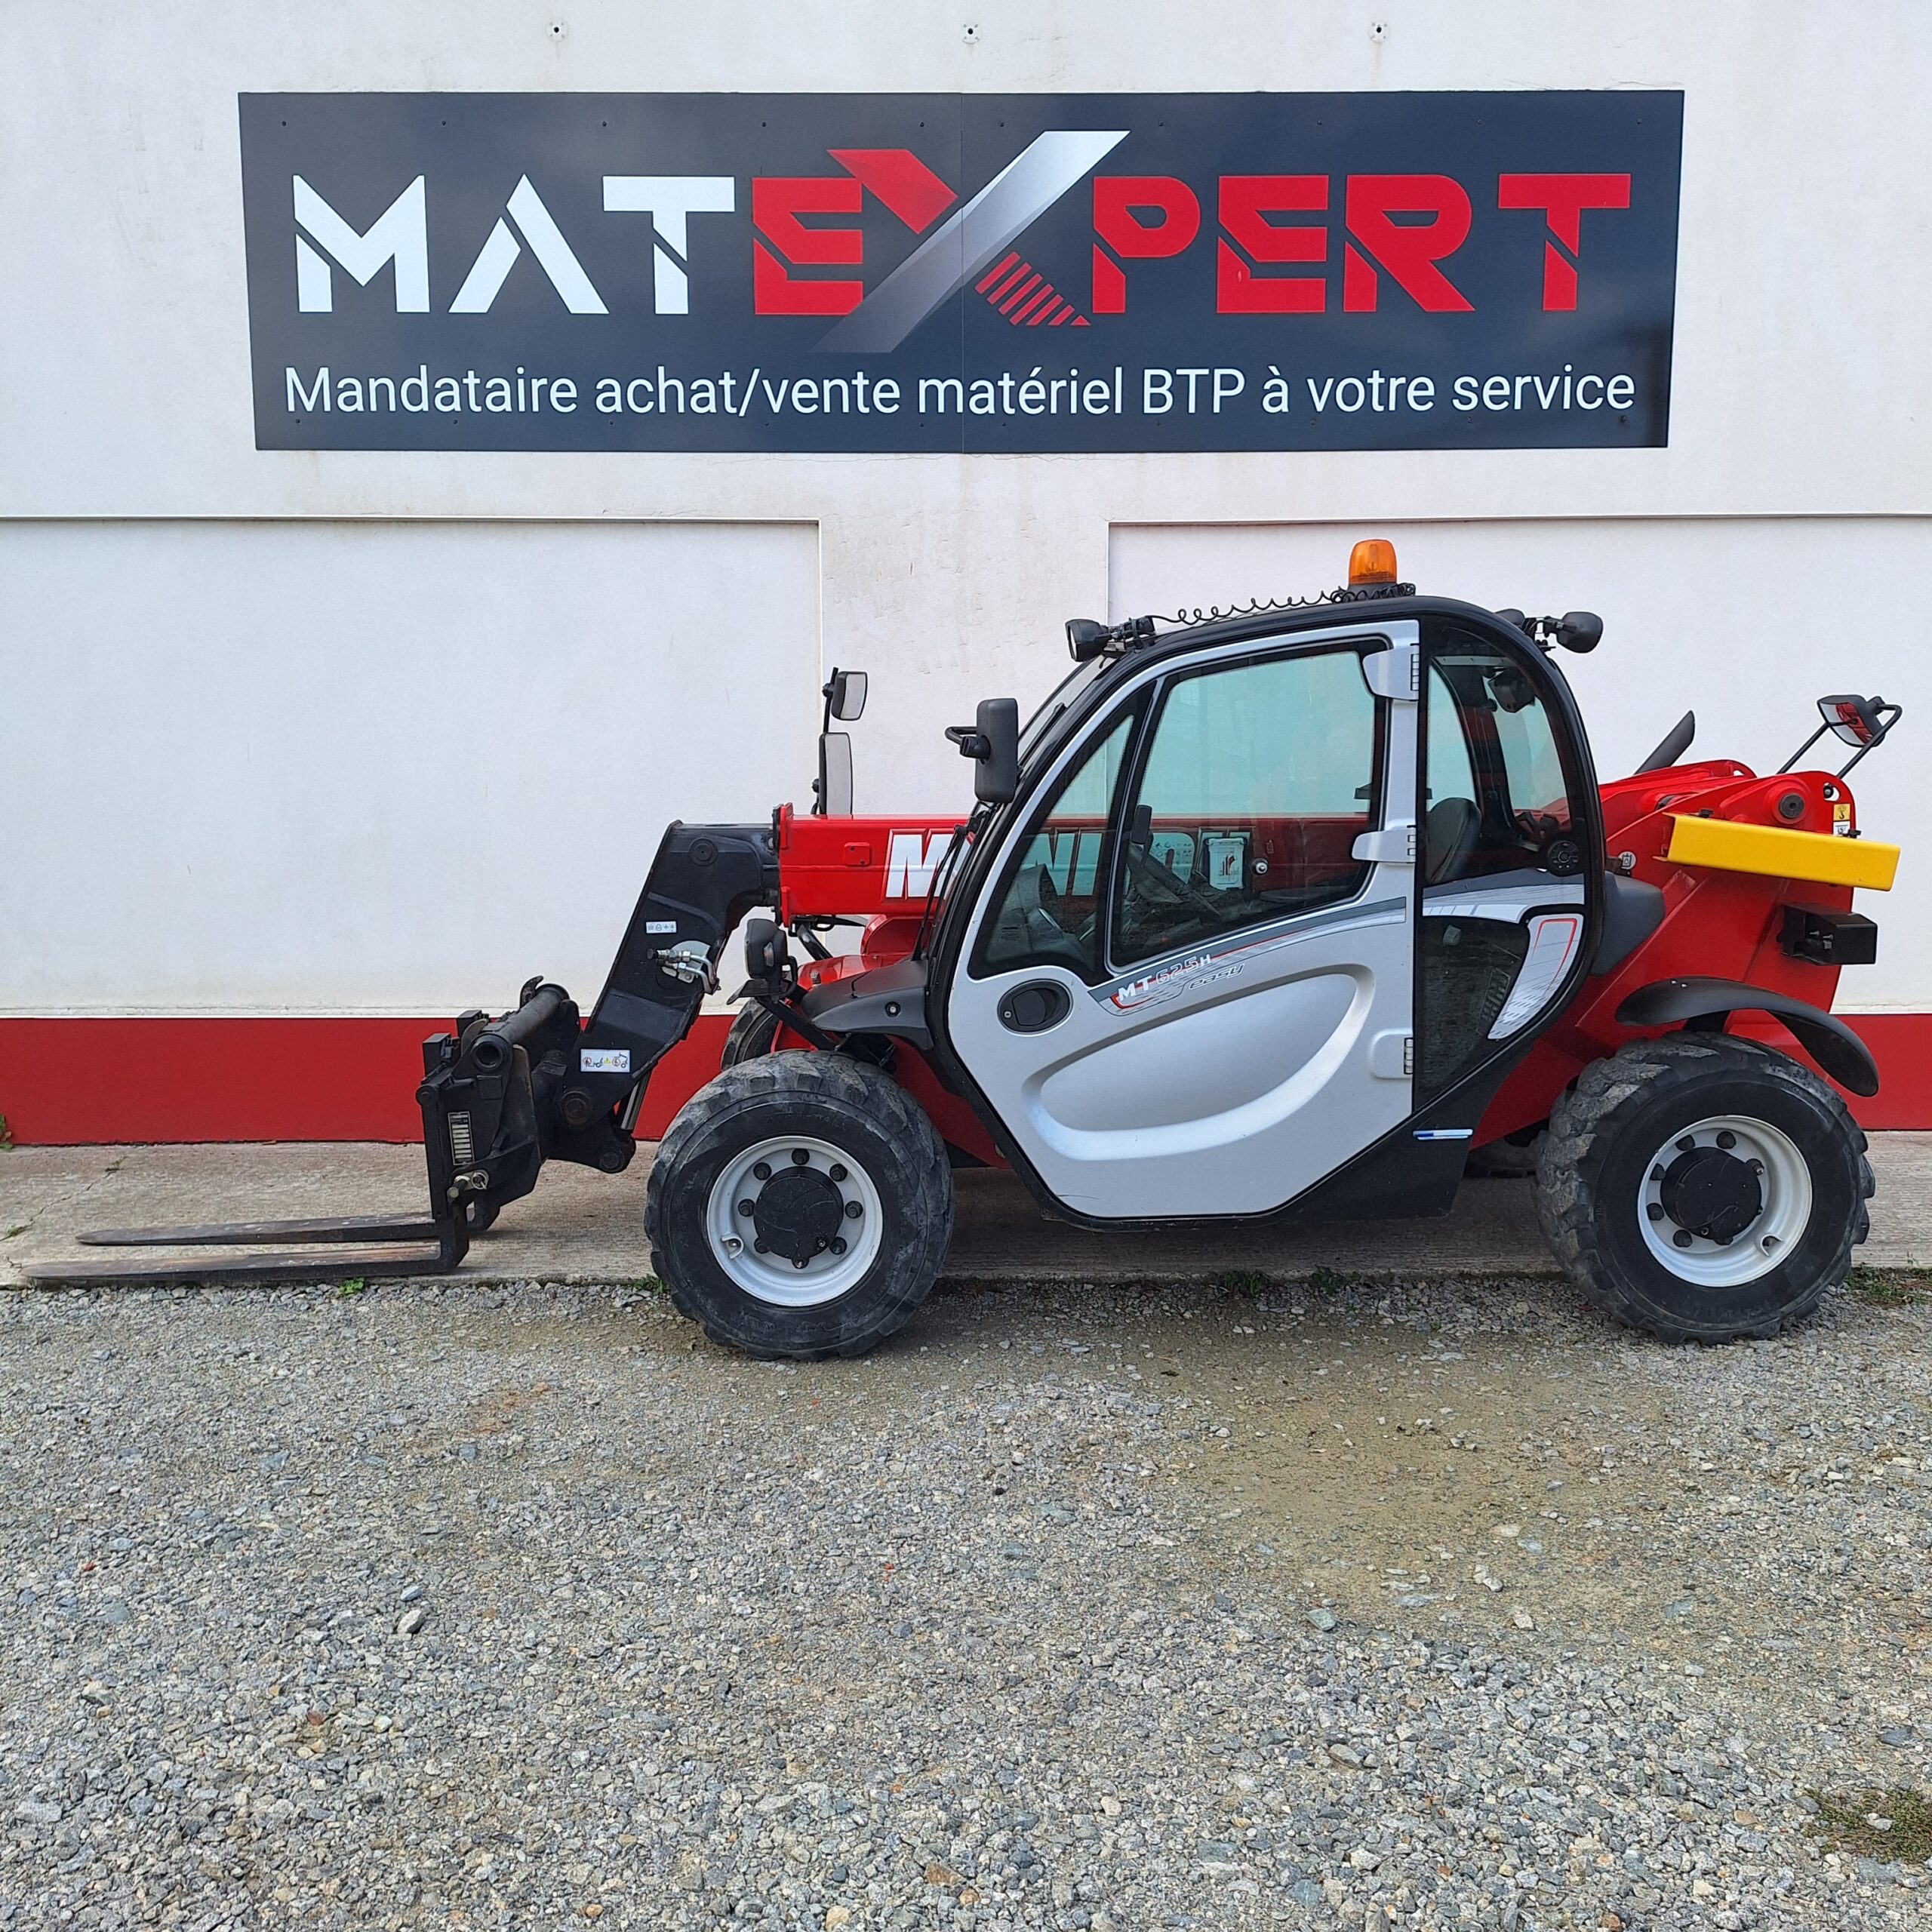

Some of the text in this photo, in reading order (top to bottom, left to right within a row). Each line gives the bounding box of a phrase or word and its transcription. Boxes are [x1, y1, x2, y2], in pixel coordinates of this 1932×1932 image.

[293, 130, 1632, 352] MATEXPERT
[285, 365, 1635, 417] Mandataire achat/vente matériel BTP à votre service
[1188, 963, 1245, 990] easy
